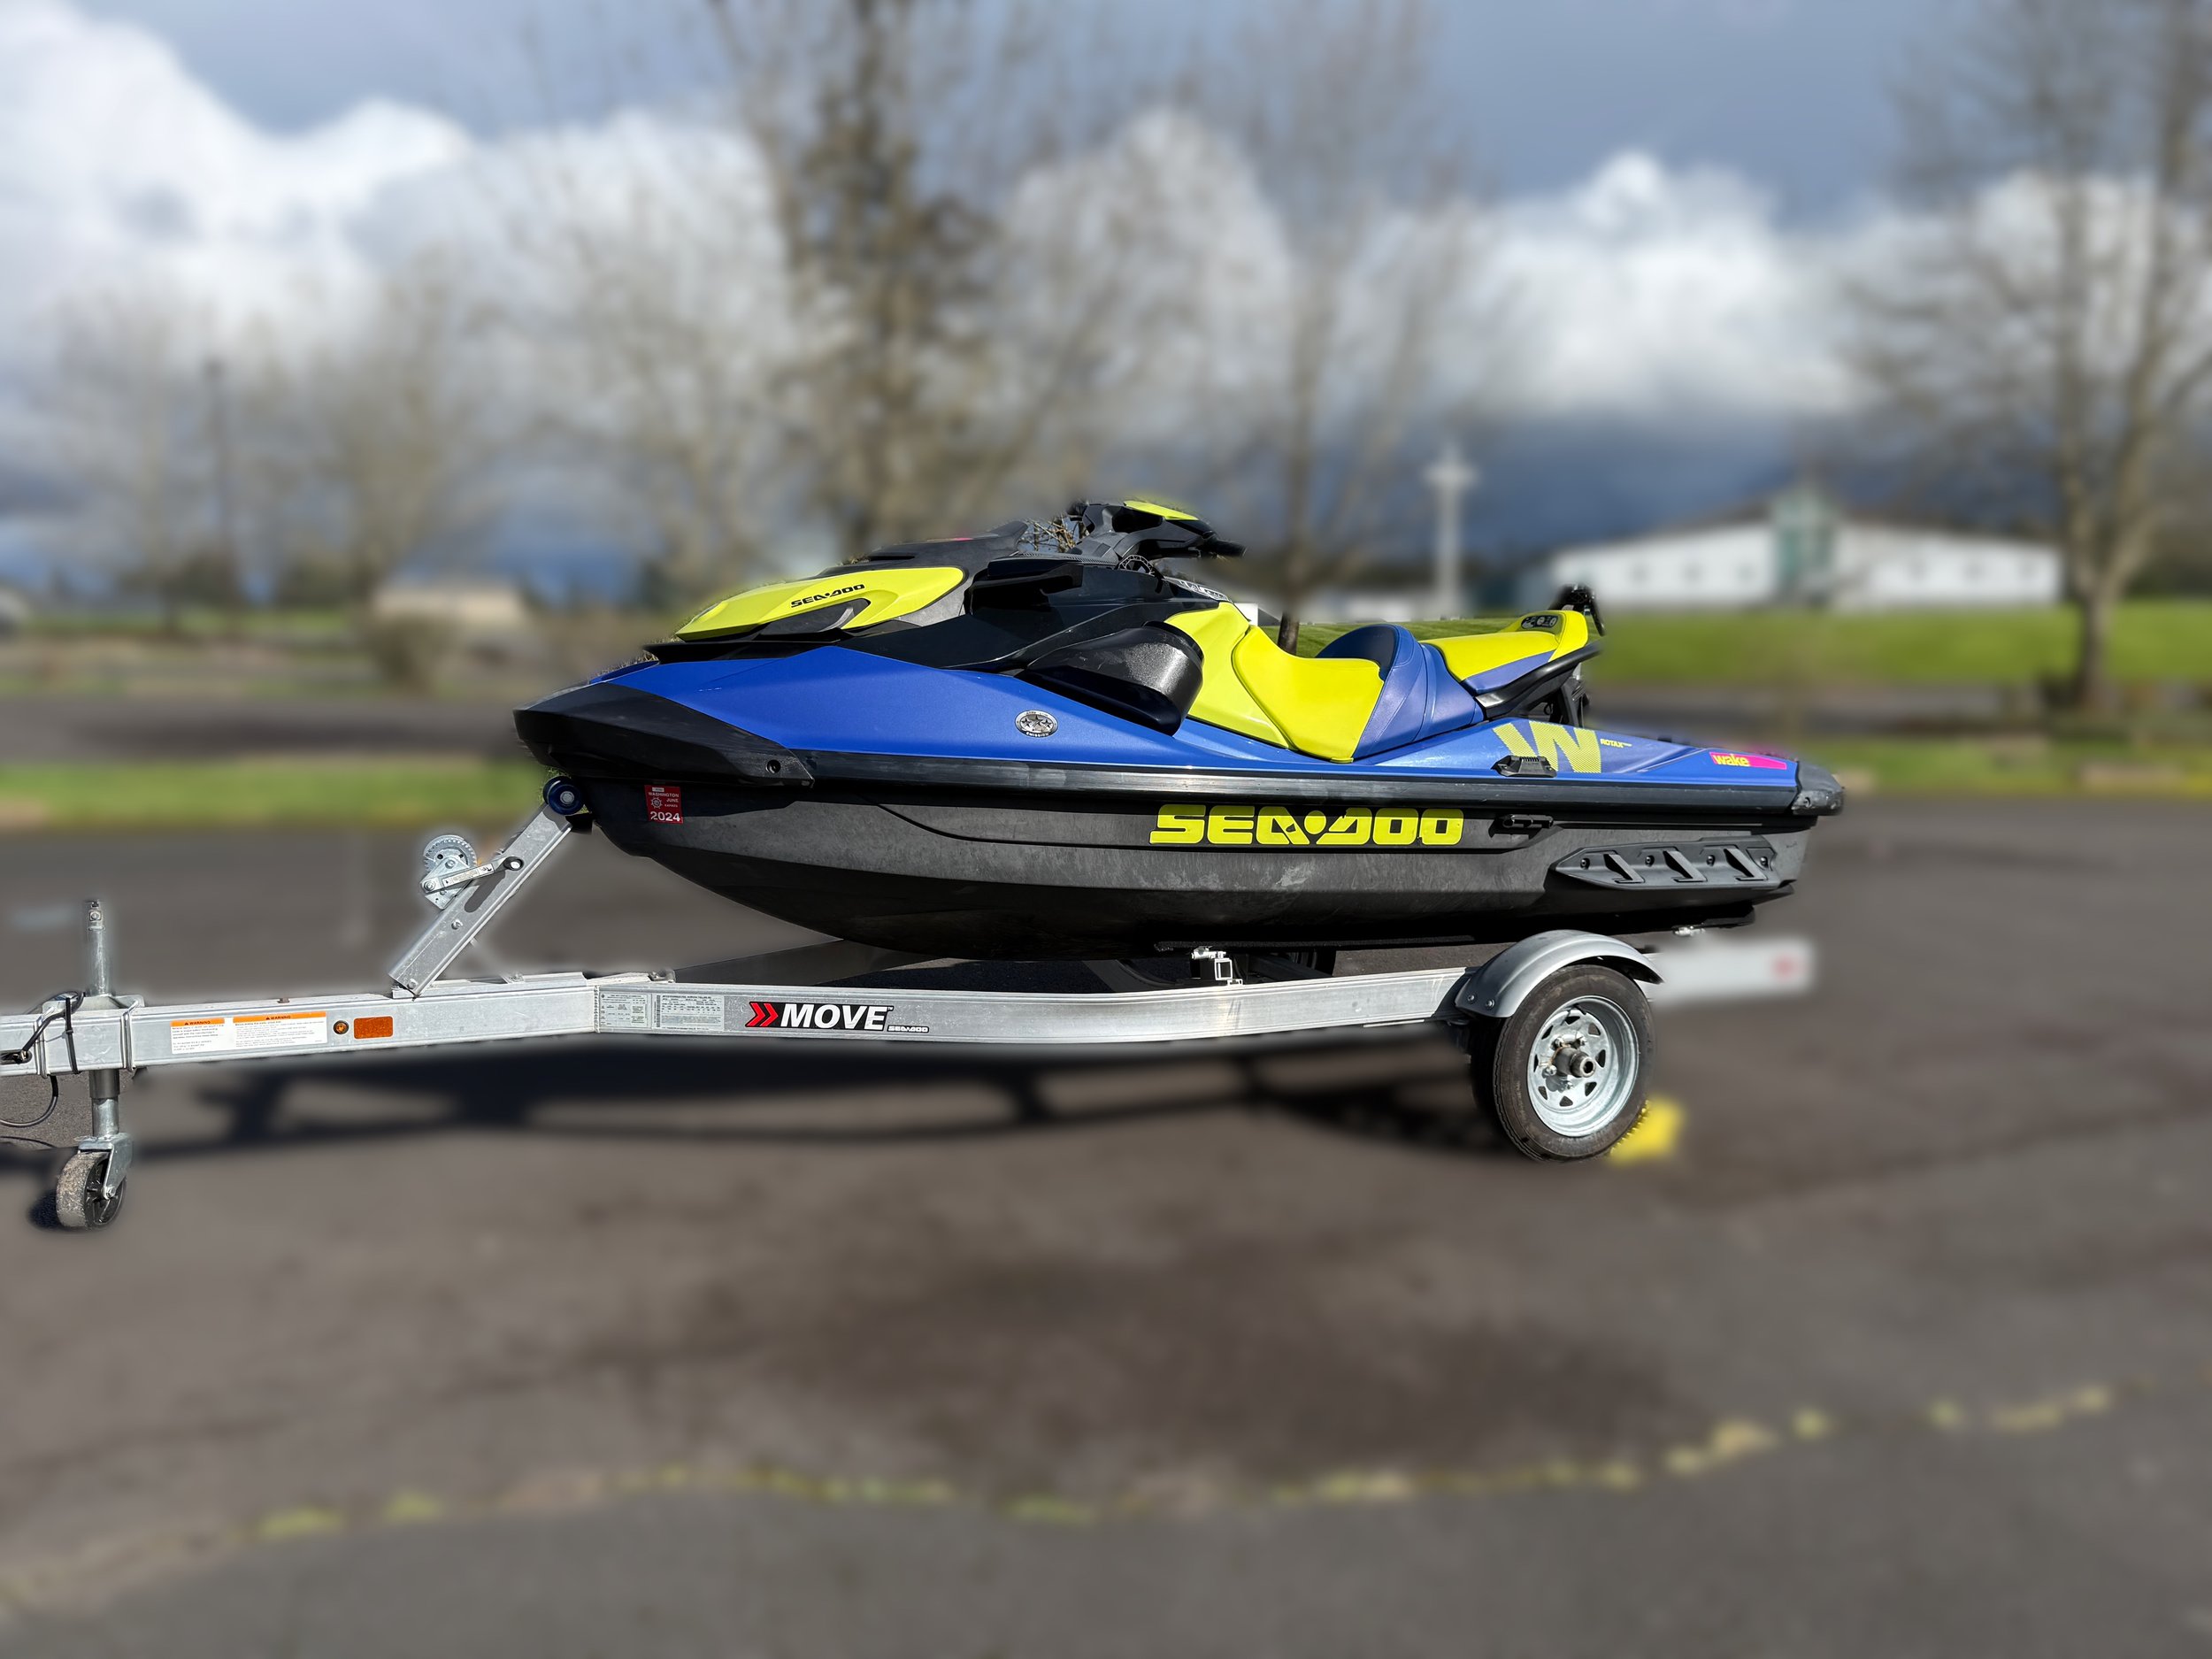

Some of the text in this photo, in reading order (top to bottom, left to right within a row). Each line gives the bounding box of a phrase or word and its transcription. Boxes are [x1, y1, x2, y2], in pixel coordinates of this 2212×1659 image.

[1600, 738, 1624, 749] ROTAX
[1713, 753, 1750, 767] wake
[650, 810, 680, 822] 2024
